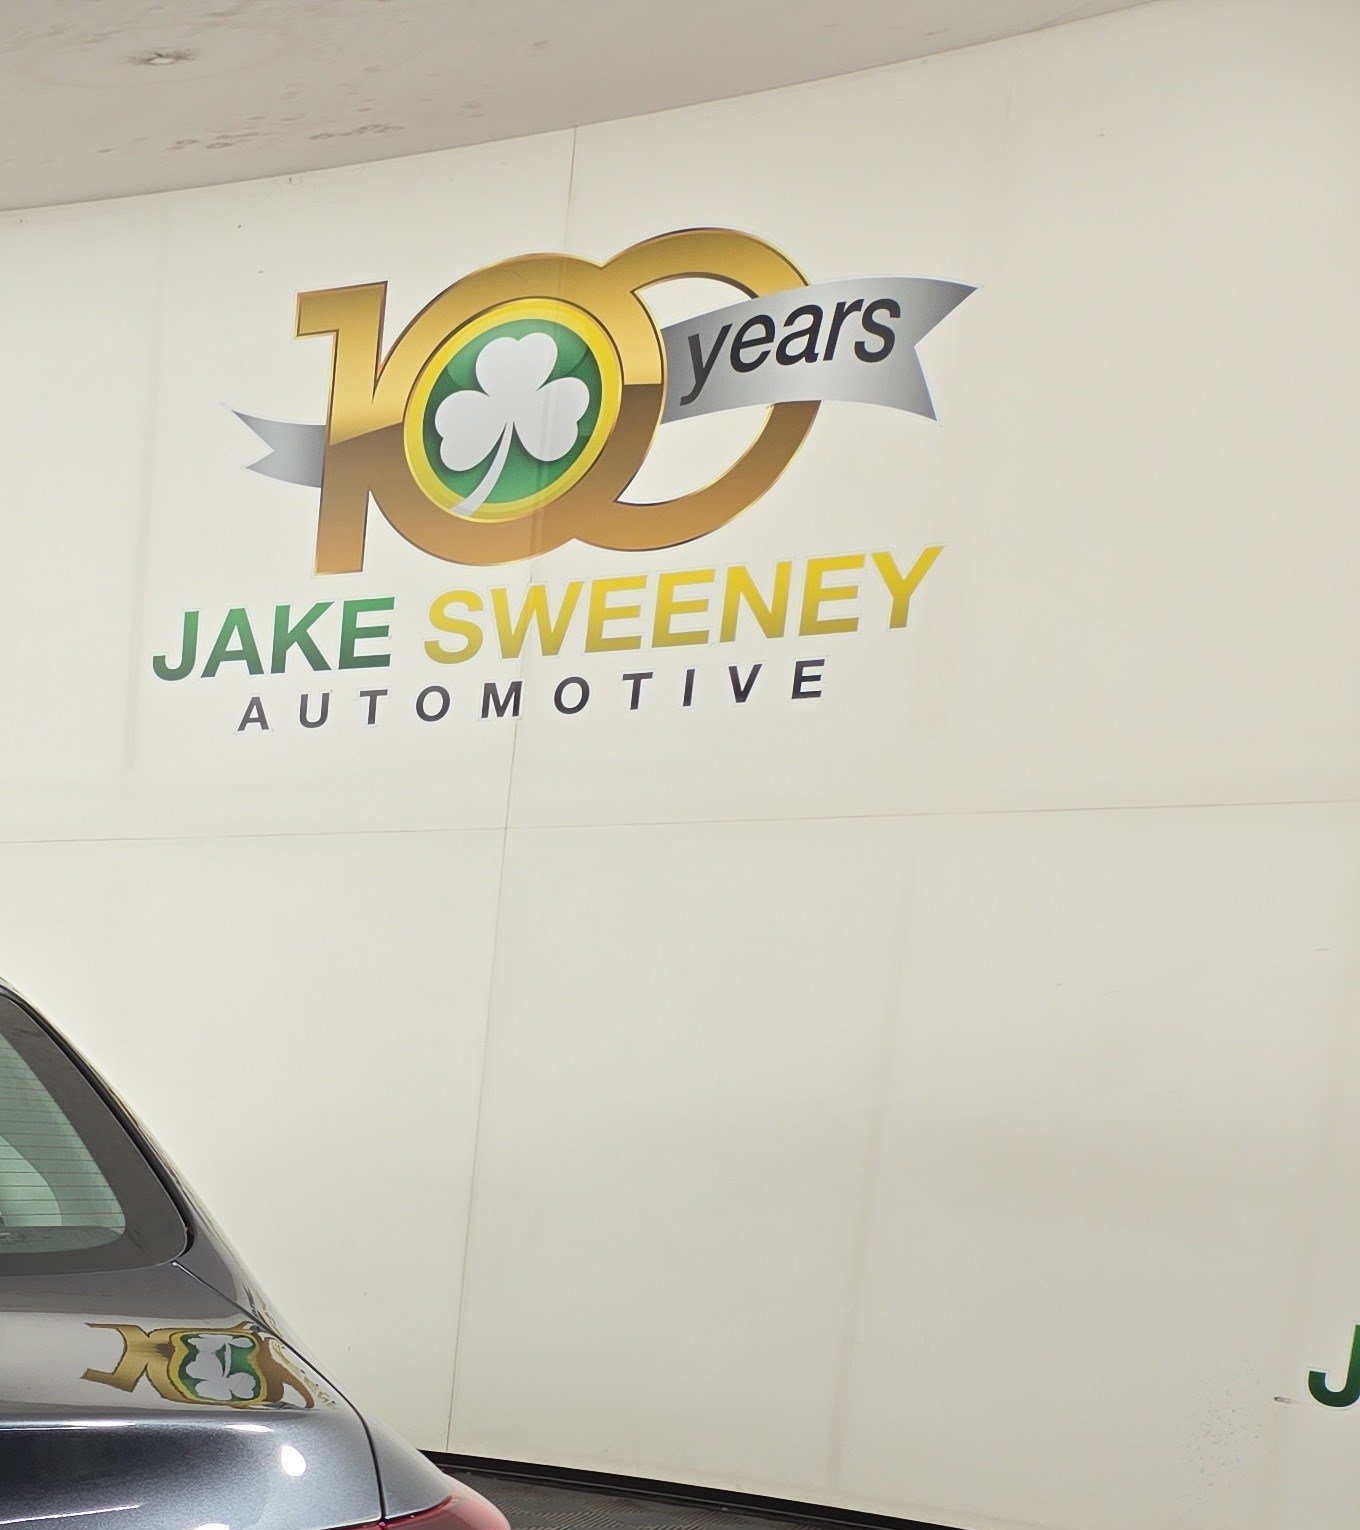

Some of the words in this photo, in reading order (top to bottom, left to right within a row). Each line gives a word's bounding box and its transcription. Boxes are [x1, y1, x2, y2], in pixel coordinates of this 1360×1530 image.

[680, 296, 901, 406] years
[152, 596, 396, 682] JAKE
[423, 545, 944, 665] SWEENEY
[237, 658, 827, 732] AUTOMOTIVE
